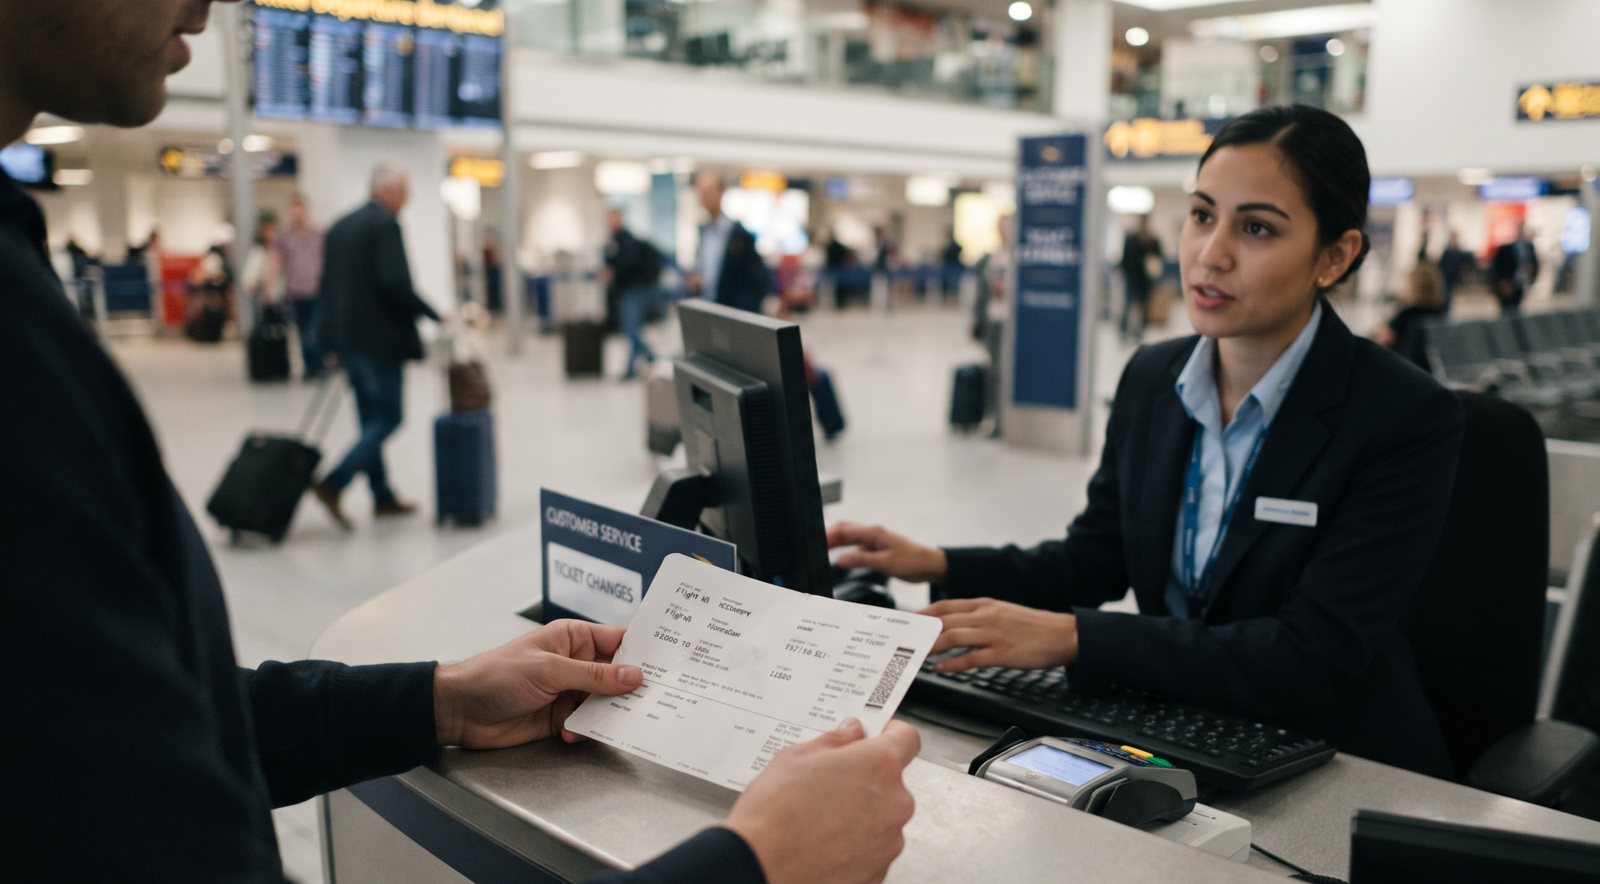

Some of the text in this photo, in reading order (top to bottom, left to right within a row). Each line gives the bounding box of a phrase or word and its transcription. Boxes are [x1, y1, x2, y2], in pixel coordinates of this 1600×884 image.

[546, 506, 642, 553] CUSTOMER SERVICE
[553, 560, 635, 603] TICKET CHANGES
